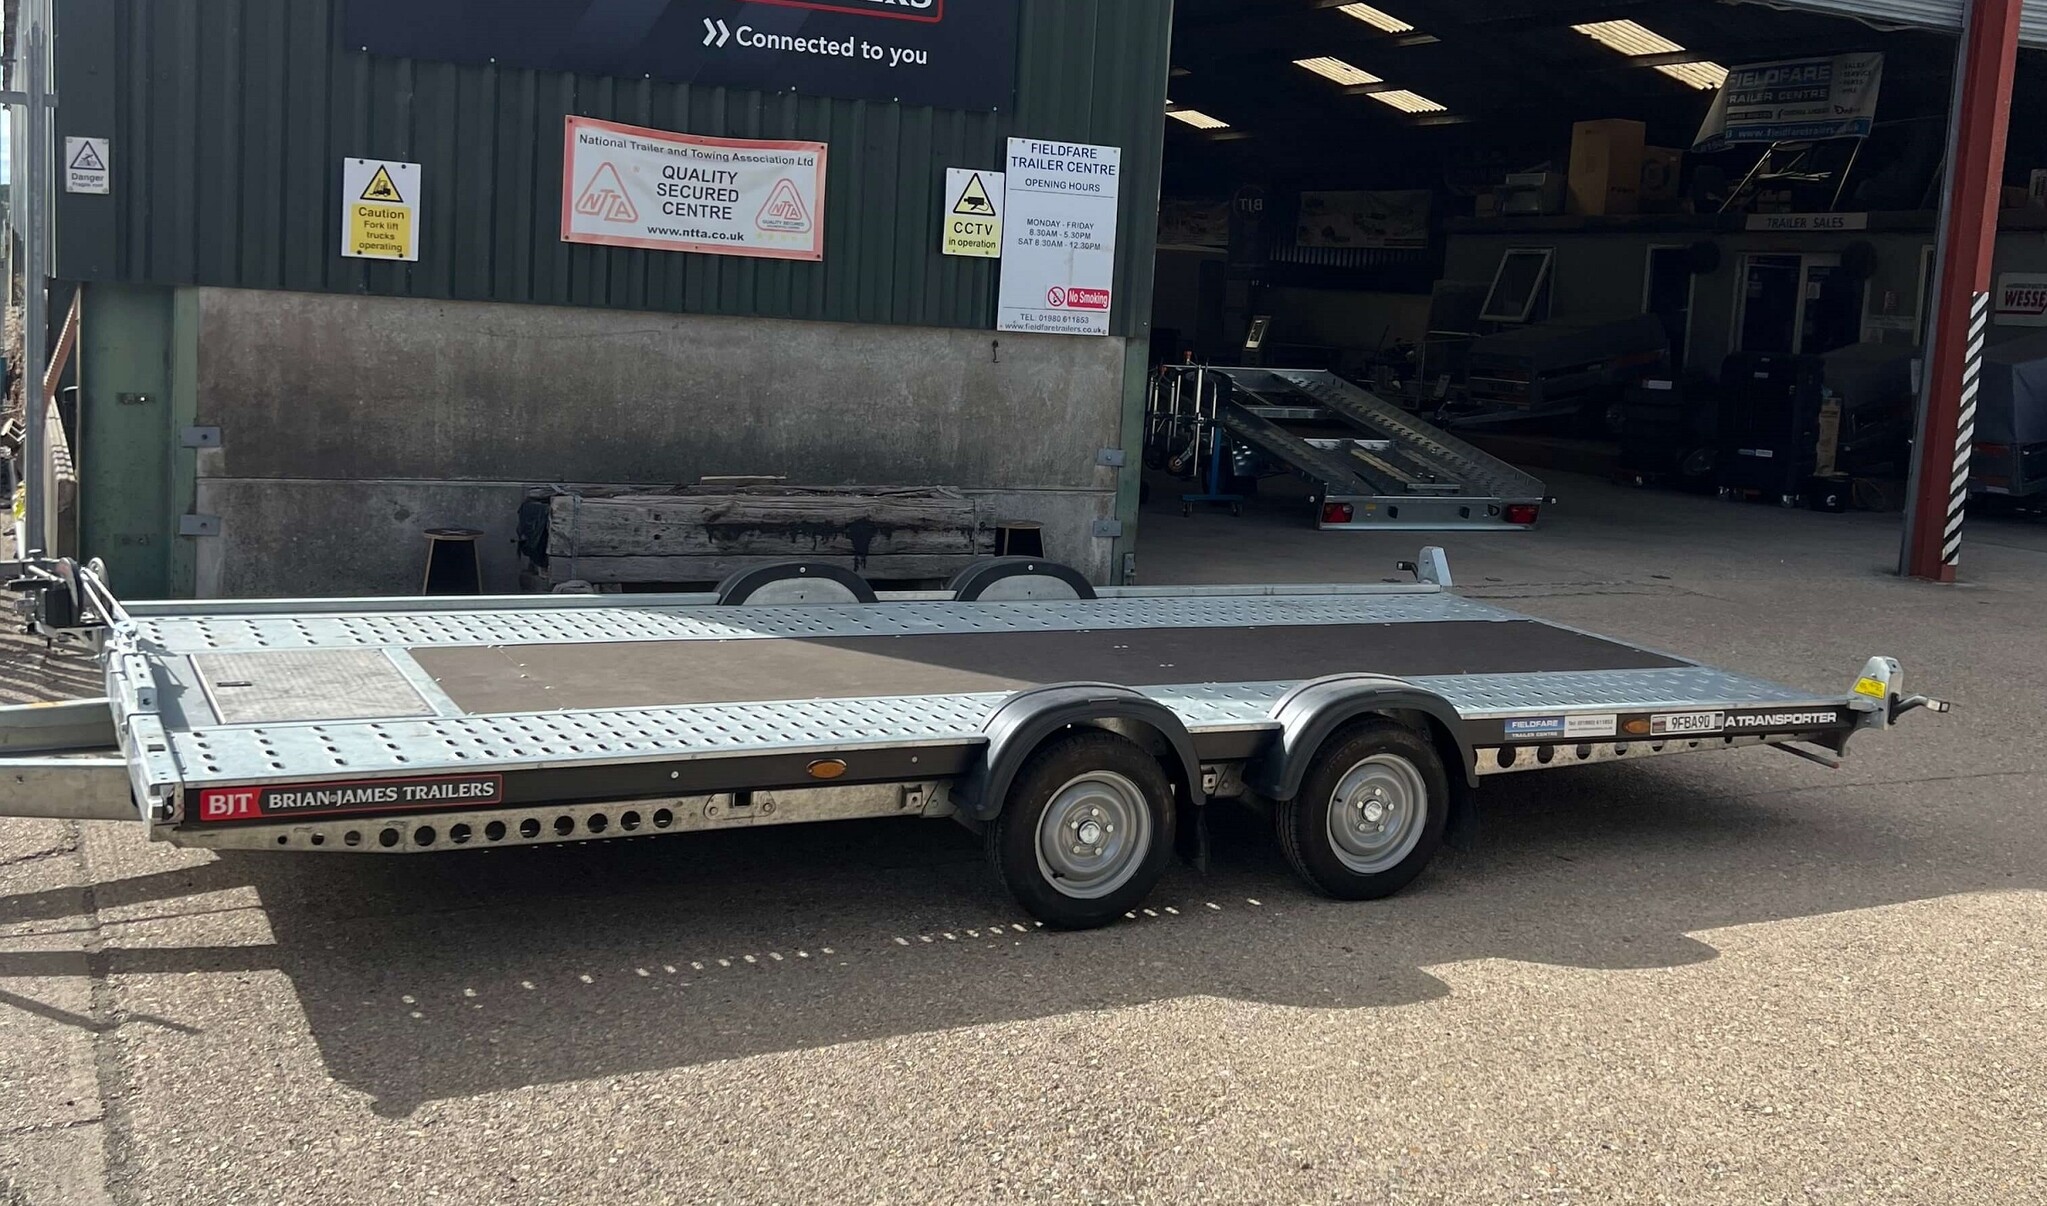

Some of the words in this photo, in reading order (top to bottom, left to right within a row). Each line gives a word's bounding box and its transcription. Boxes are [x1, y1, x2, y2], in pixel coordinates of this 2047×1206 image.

[735, 25, 855, 57] Connected
[861, 40, 884, 60] to
[889, 46, 928, 67] you
[1728, 64, 1832, 89] FIELDFARE
[1728, 90, 1773, 104] RAILER
[1778, 88, 1828, 100] CENTRE
[579, 133, 627, 149] National
[630, 141, 665, 153] Trailer
[667, 148, 688, 157] and
[691, 149, 729, 162] Towing
[732, 153, 795, 165] Association
[797, 157, 814, 166] Ltd
[1031, 143, 1097, 159] FIELDFARE
[1011, 156, 1064, 171] TRAILER
[1067, 161, 1116, 176] CENTRE
[71, 172, 105, 183] Danger
[662, 165, 738, 185] QUALITY
[656, 182, 739, 203] SECURED
[1025, 178, 1067, 190] OPENING
[1069, 181, 1101, 192] HOURS
[579, 189, 635, 220] NTTA
[662, 201, 733, 220] CENTRE
[768, 200, 802, 219] NTTA
[358, 206, 405, 220] Caution
[364, 220, 385, 229] Fork
[386, 221, 399, 231] lift
[953, 221, 993, 236] CCTV
[1026, 218, 1061, 228] MONDAY
[1066, 221, 1095, 230] FRIDAY
[1767, 216, 1807, 228] TRAILER
[1813, 216, 1844, 228] SALES
[366, 231, 395, 240] trucks
[647, 225, 745, 242] www.ntta.co.uk
[1029, 228, 1058, 238] 8.30AM
[1063, 231, 1091, 239] 5.30PM
[358, 241, 403, 252] operating
[948, 236, 956, 246] in
[957, 239, 996, 249] operation
[1018, 237, 1033, 246] SAT
[1034, 239, 1063, 248] 8.30AM
[1069, 241, 1101, 250] 12.30PM
[1068, 290, 1078, 303] No
[1080, 291, 1108, 307] Smoking
[2005, 290, 2047, 307] WESSE
[1038, 314, 1061, 322] 01980
[1063, 316, 1089, 324] 611853
[1005, 322, 1101, 333] www.fieldfaretrailers.co.uk
[1511, 719, 1559, 729] FIELDFARE
[1725, 715, 1737, 728] A
[1736, 711, 1837, 727] TRANSPORTER
[402, 780, 495, 801] TRAILERS
[208, 792, 253, 816] BJT
